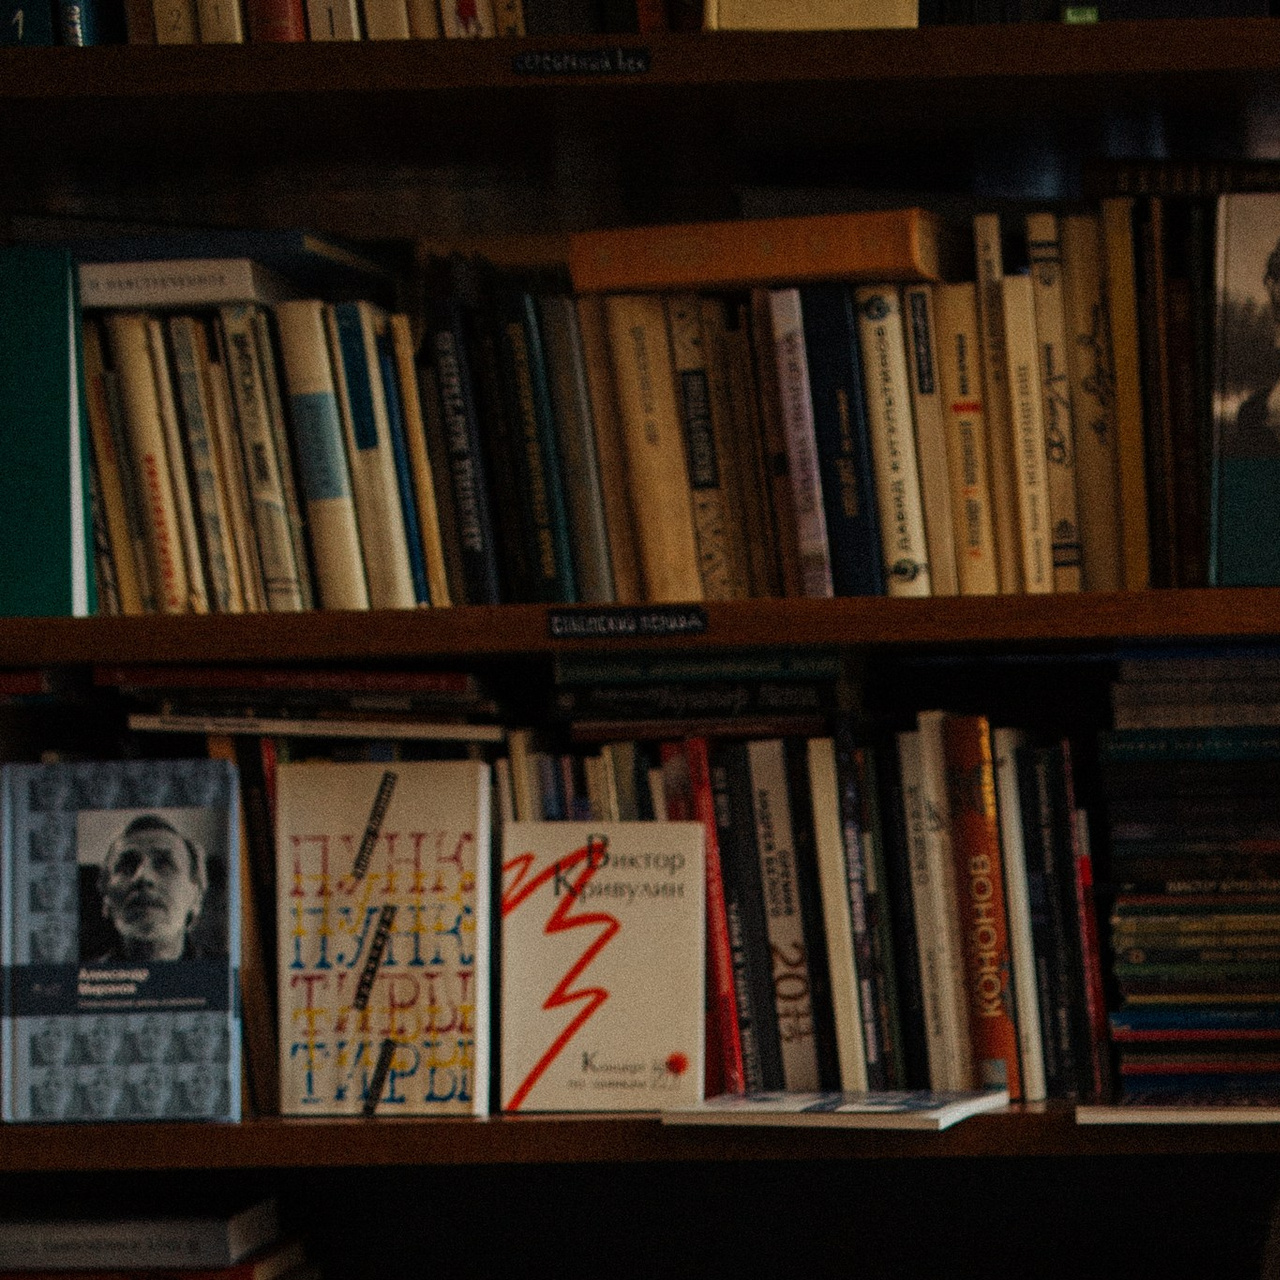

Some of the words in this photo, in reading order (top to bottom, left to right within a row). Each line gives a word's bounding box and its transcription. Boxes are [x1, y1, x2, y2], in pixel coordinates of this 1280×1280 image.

[891, 480, 911, 551] ДАВИД
[756, 789, 774, 851] АНДРЕЯ
[554, 862, 685, 903] Кривулин
[586, 833, 686, 875] Виктор
[779, 850, 796, 916] ПРЕМИЯ
[764, 857, 781, 917] БЕЛОГО
[969, 853, 1003, 1018] КОНОНОВ
